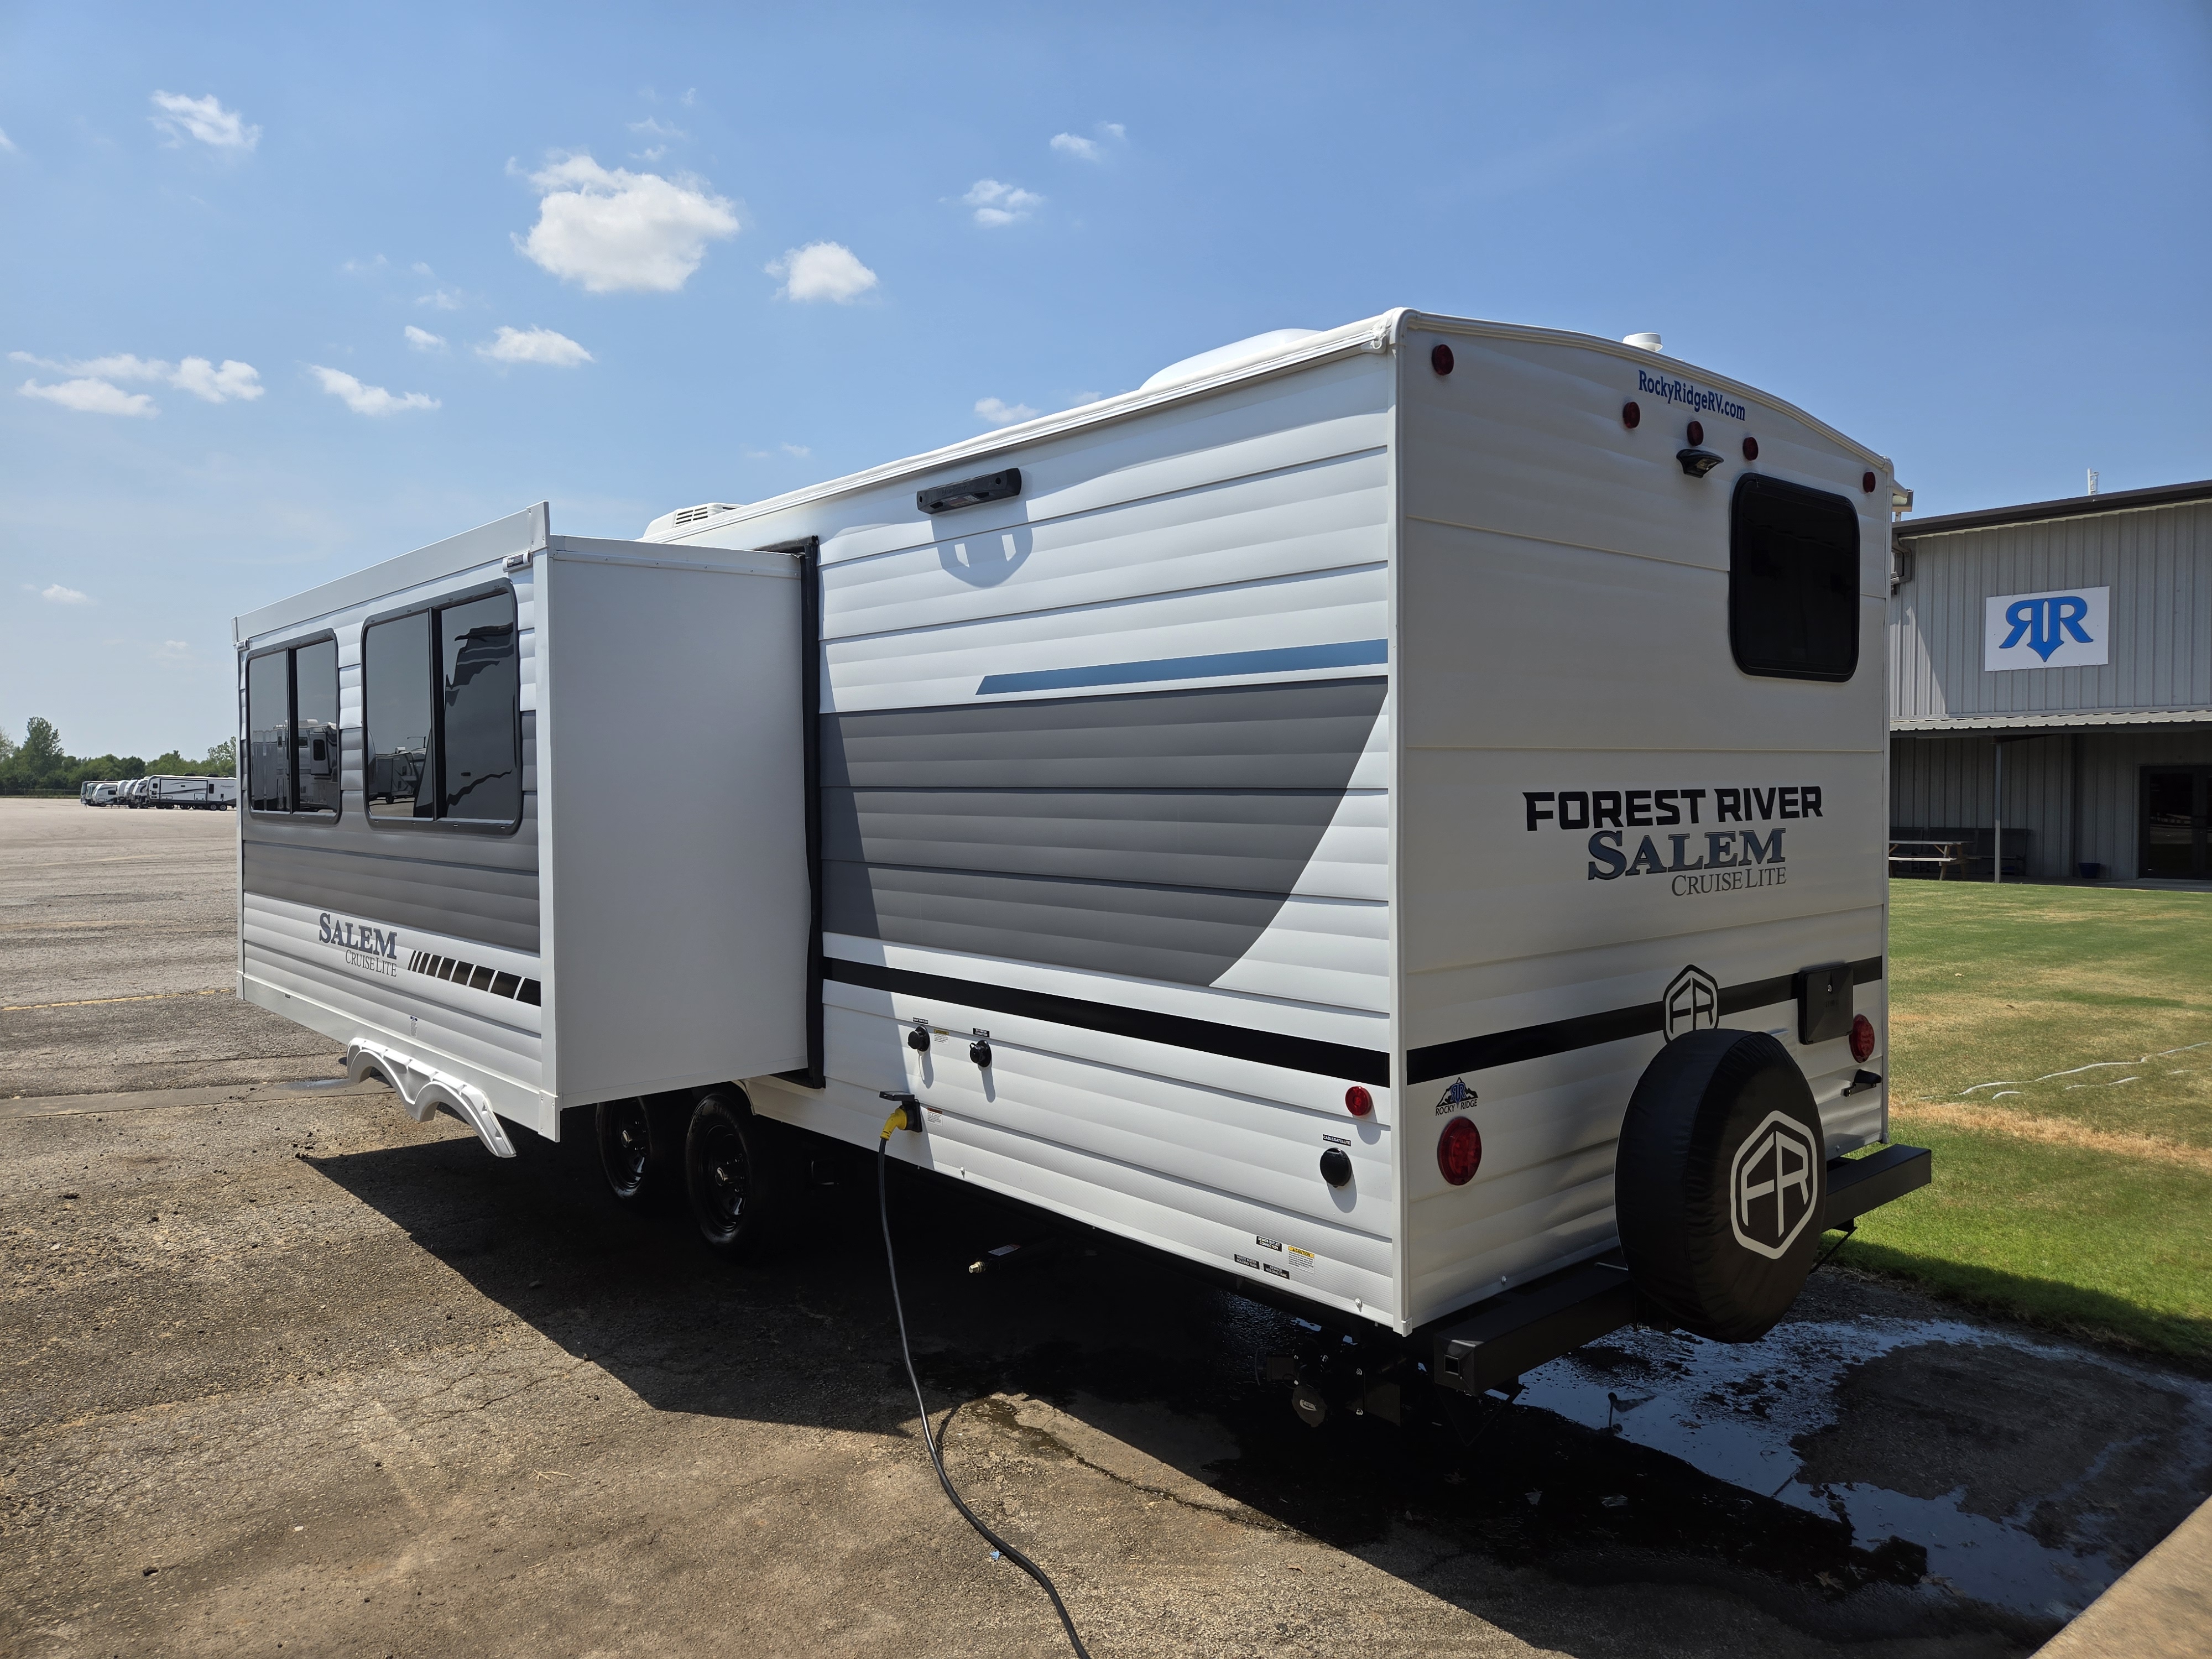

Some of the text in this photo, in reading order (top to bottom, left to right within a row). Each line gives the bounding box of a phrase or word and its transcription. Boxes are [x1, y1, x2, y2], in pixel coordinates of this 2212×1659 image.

[1639, 370, 1745, 421] RockyRidgeRV.com
[1522, 786, 1823, 831] FOREST RIVER
[1588, 828, 1786, 880] SALEM
[319, 912, 398, 959] SALEM
[1435, 1098, 1478, 1116] ROCKY RIDGE
[1740, 1130, 1809, 1238] FR
[1259, 1241, 1279, 1250] CONNECTION
[1295, 1248, 1311, 1256] CAUTION
